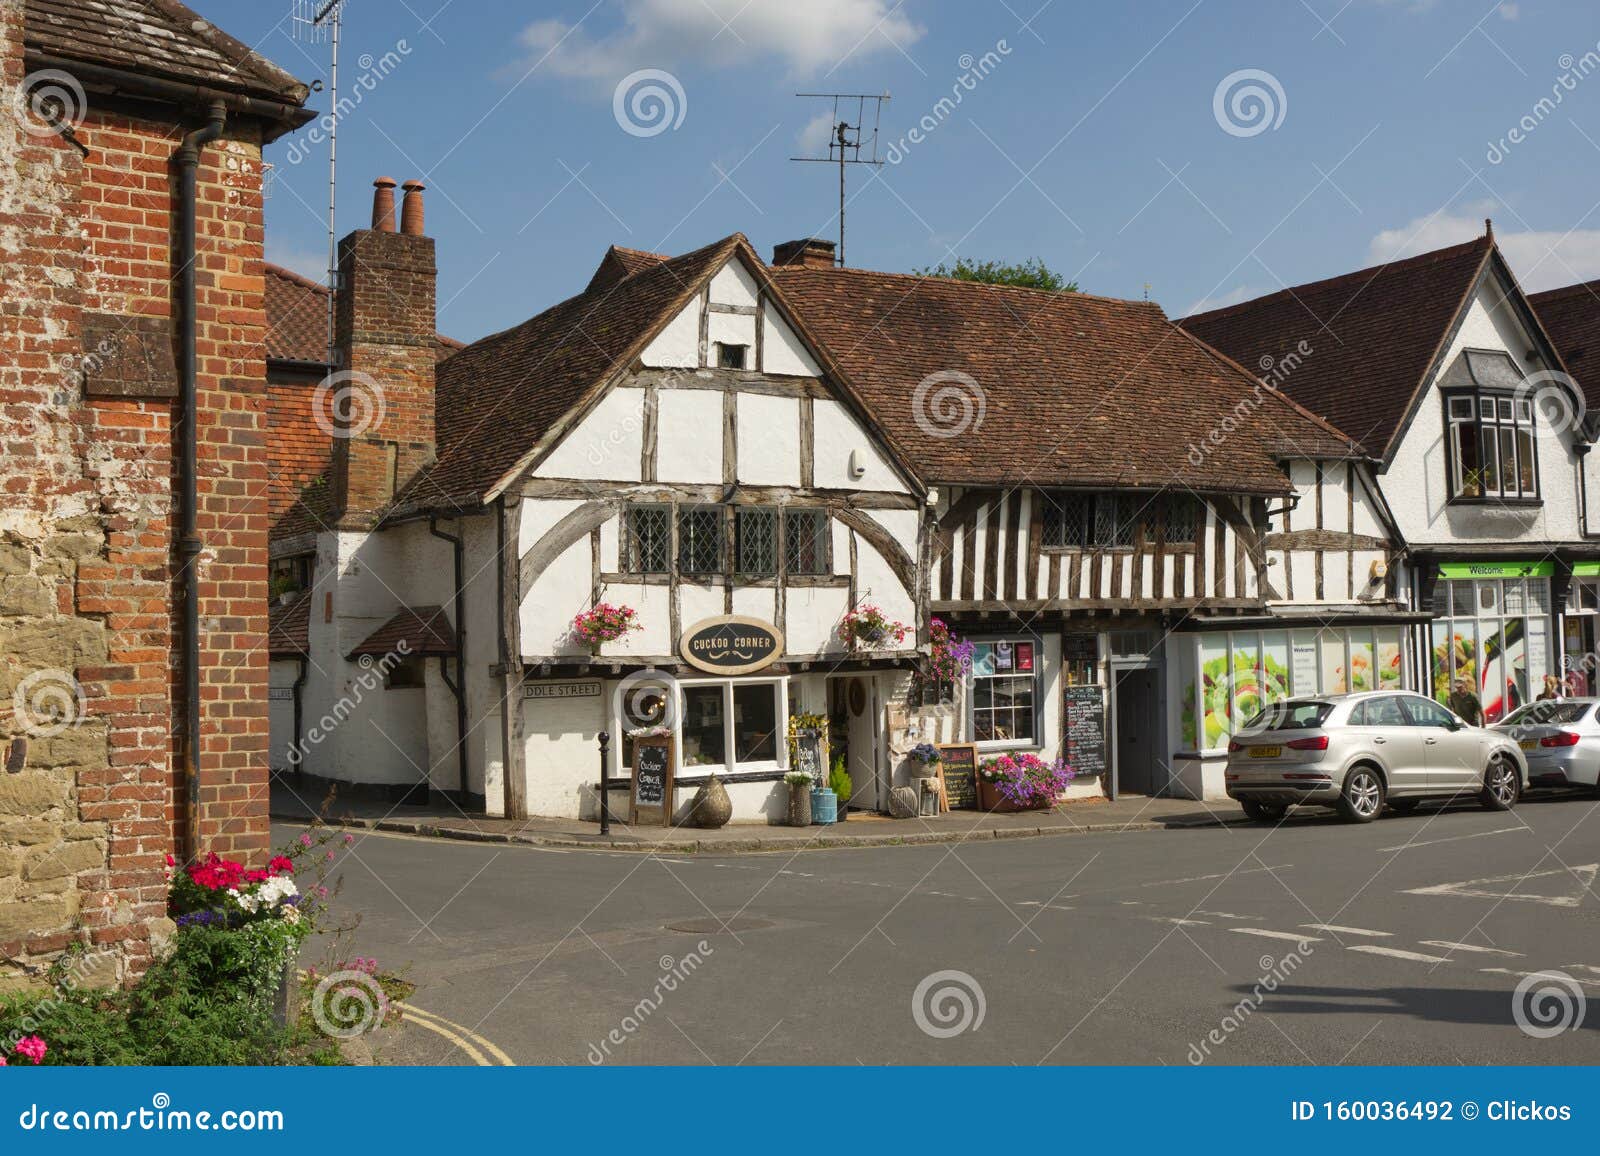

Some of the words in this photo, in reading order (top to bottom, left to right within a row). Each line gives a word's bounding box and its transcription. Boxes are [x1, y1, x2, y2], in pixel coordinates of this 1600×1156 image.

[1469, 565, 1504, 574] Welcome
[694, 638, 729, 650] CUCKOO
[734, 637, 770, 648] CORNER
[526, 686, 555, 697] DDLE
[559, 684, 597, 696] STREET
